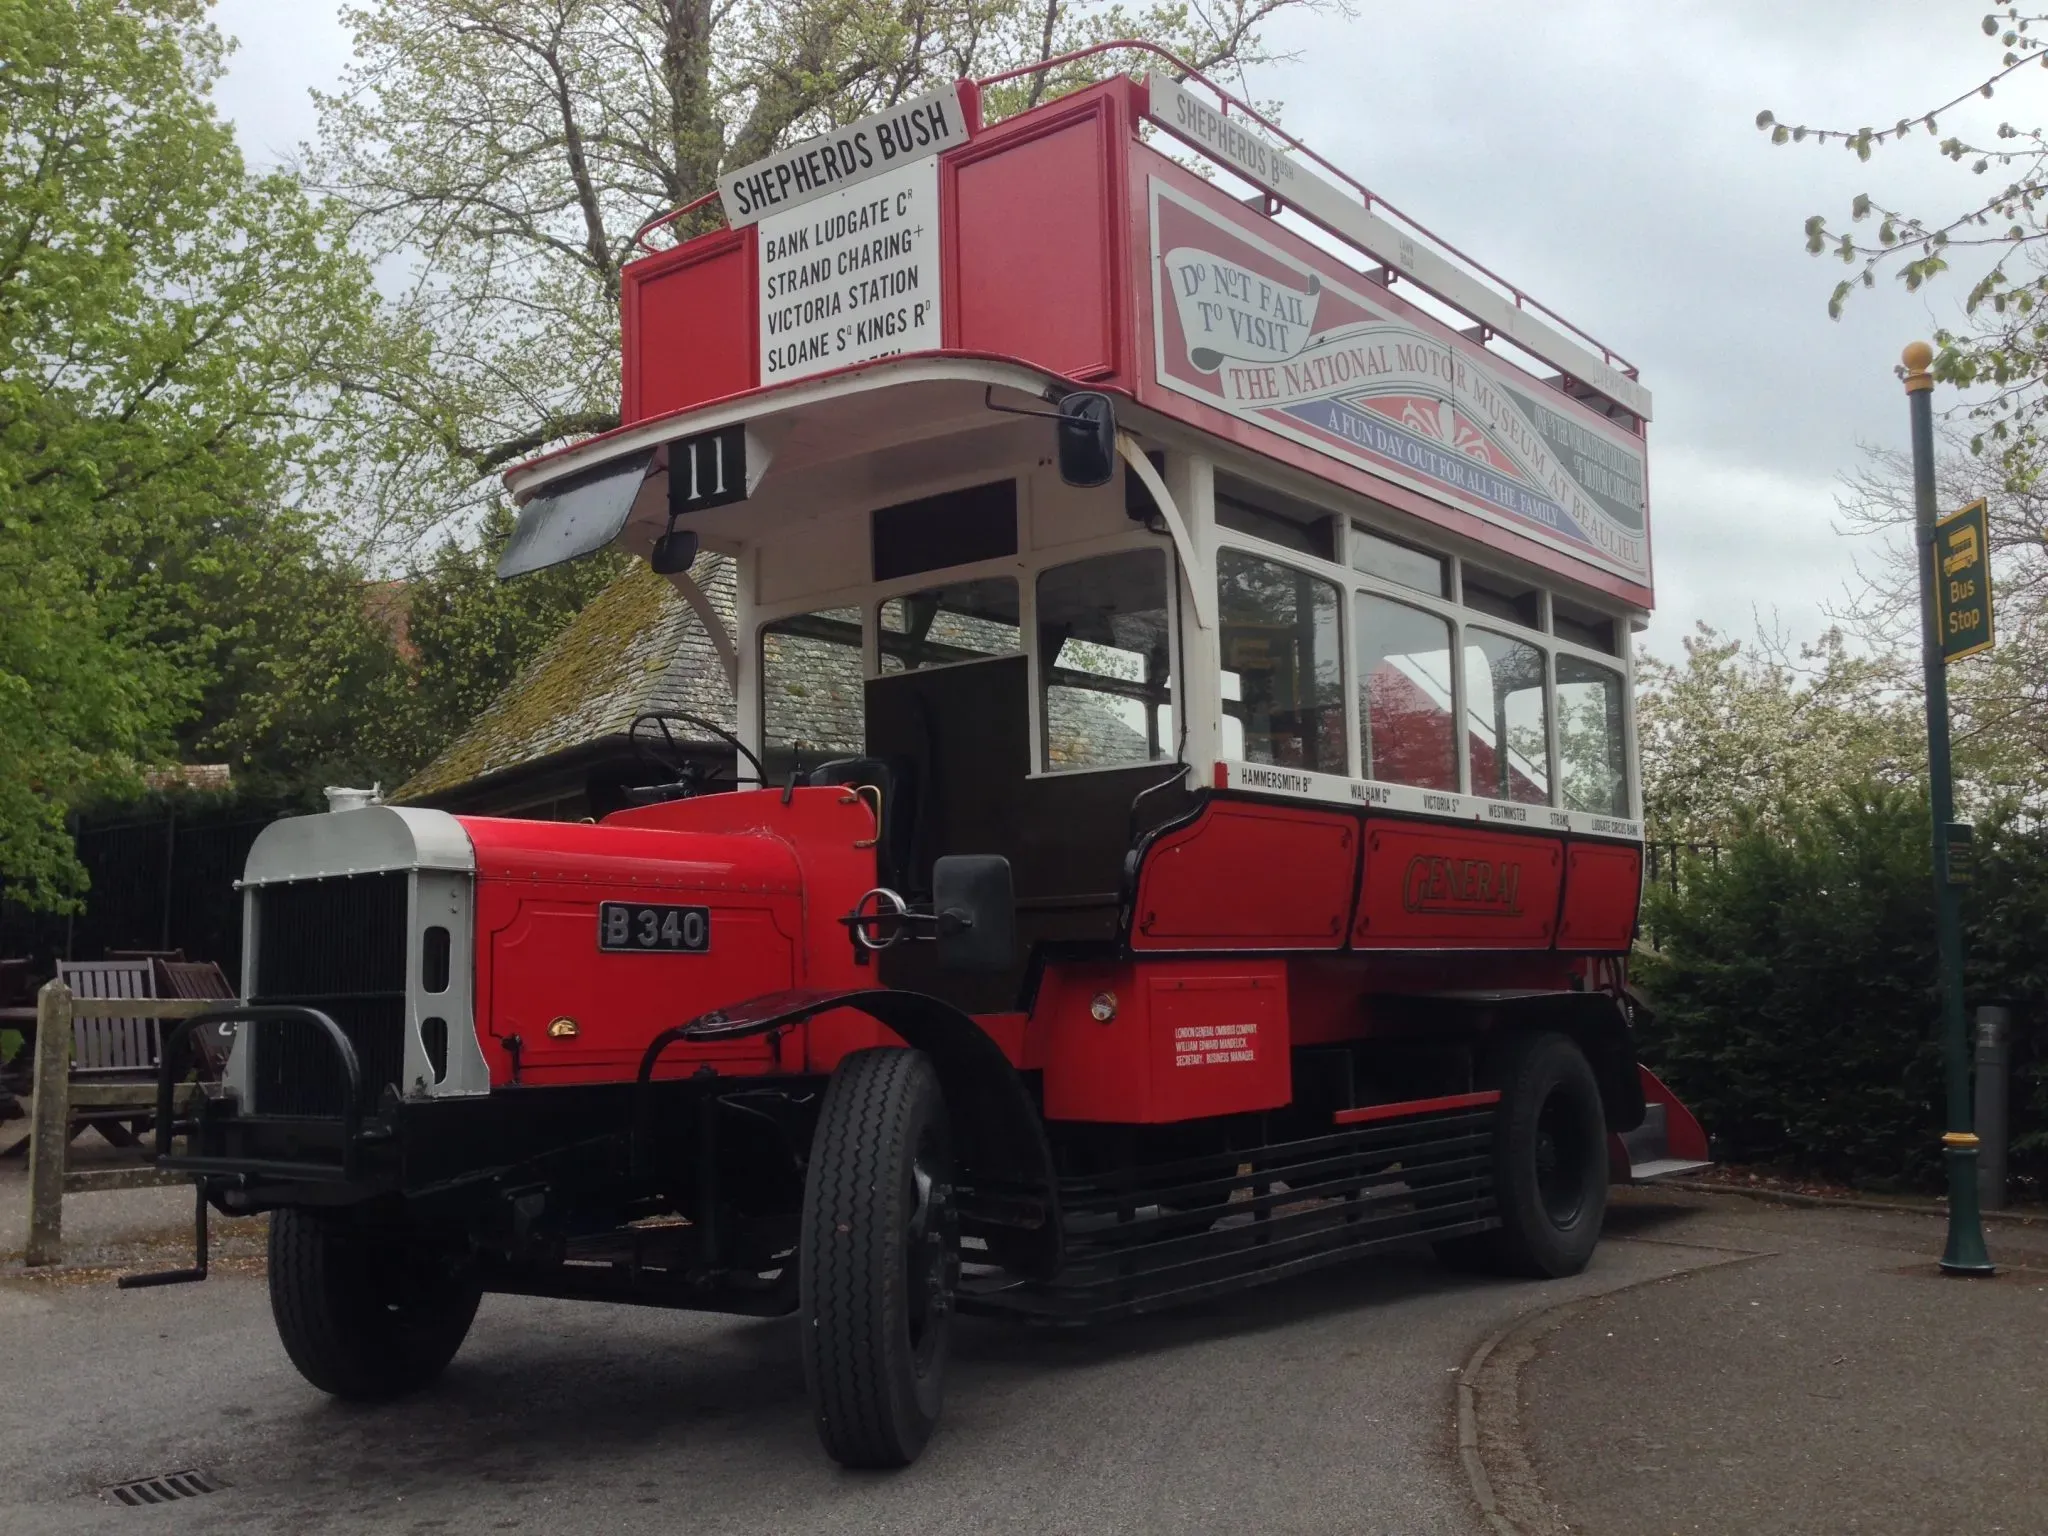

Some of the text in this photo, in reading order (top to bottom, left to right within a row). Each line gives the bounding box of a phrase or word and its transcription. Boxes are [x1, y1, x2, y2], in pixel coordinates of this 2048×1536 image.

[733, 101, 949, 215] SHEPHERDS BUSH
[1177, 94, 1266, 176] SHEPHERDS
[767, 228, 809, 263] BANK
[815, 198, 890, 246] LUDGATE
[767, 257, 831, 300] STRAND
[768, 265, 919, 335] VICTORIA STATION
[1179, 263, 1309, 328] DO NOT FAIL
[768, 332, 829, 373] SLOANE
[857, 308, 907, 345] KINGS
[1198, 301, 1289, 354] TO VISIT
[688, 436, 728, 500] 11
[1229, 343, 1640, 563] THE NATIONAL MOTOR MUSEUM AT BEAULIEU
[1328, 407, 1559, 526] A FUN DAY OUT FOR ALL THE FAMILY
[1950, 579, 1975, 603] Bus
[1949, 608, 1980, 634] Stop
[1242, 768, 1301, 792] HAMMERSMITH
[1351, 784, 1381, 802] WALHAM
[1423, 794, 1451, 812] VICTORIA
[1489, 804, 1527, 822] WESTMINSTER
[1550, 812, 1569, 827] STRAND
[1404, 854, 1524, 916] GENERAL
[607, 906, 704, 948] B 340
